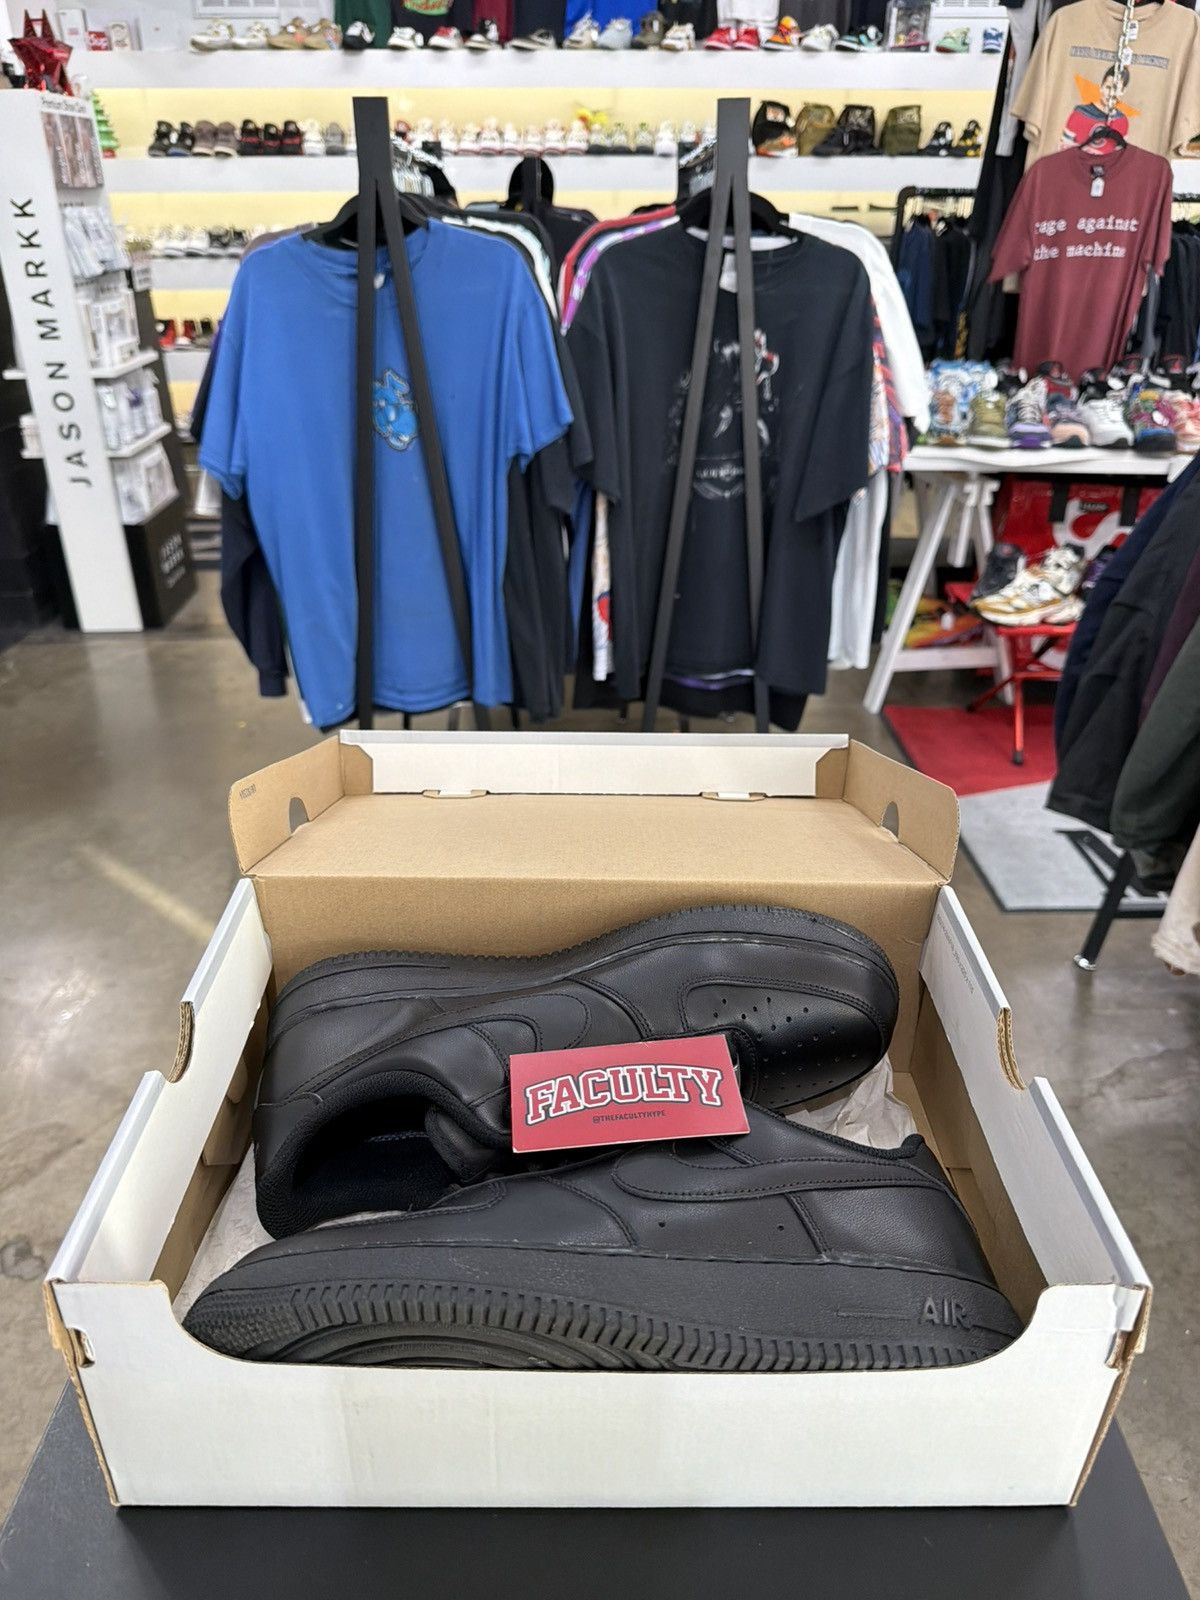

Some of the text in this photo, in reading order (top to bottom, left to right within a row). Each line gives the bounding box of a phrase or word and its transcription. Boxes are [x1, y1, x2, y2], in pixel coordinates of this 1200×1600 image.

[1033, 244, 1060, 261] the
[10, 198, 92, 486] JASON MARKK
[525, 1064, 723, 1125] FACULTY
[592, 1109, 667, 1124] @THEFACULTYHYPE
[919, 1295, 970, 1329] AIR
